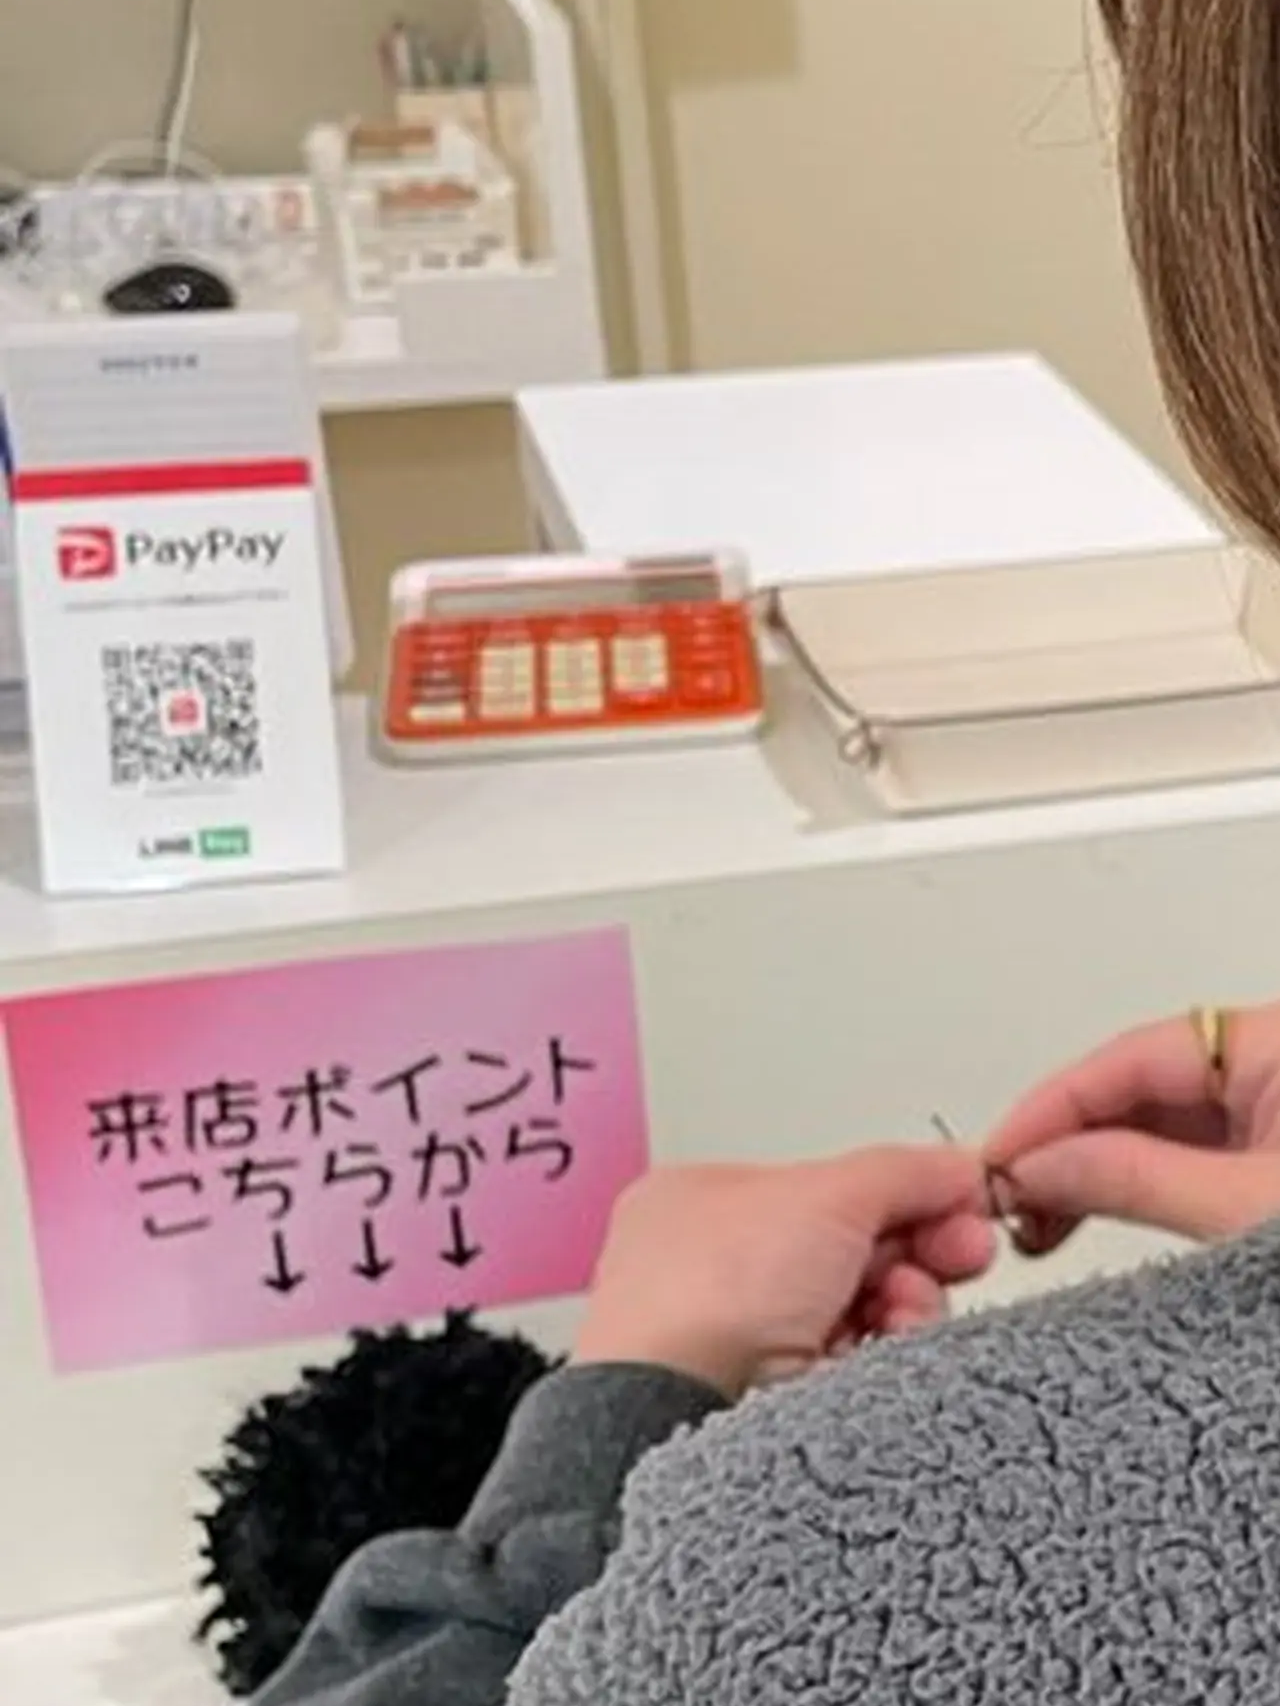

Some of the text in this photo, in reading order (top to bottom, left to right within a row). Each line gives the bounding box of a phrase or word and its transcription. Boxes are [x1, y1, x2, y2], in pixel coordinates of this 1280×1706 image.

[126, 527, 285, 572] PayPay
[87, 1038, 597, 1163] 来店ポイント
[138, 1118, 573, 1239] こちらから
